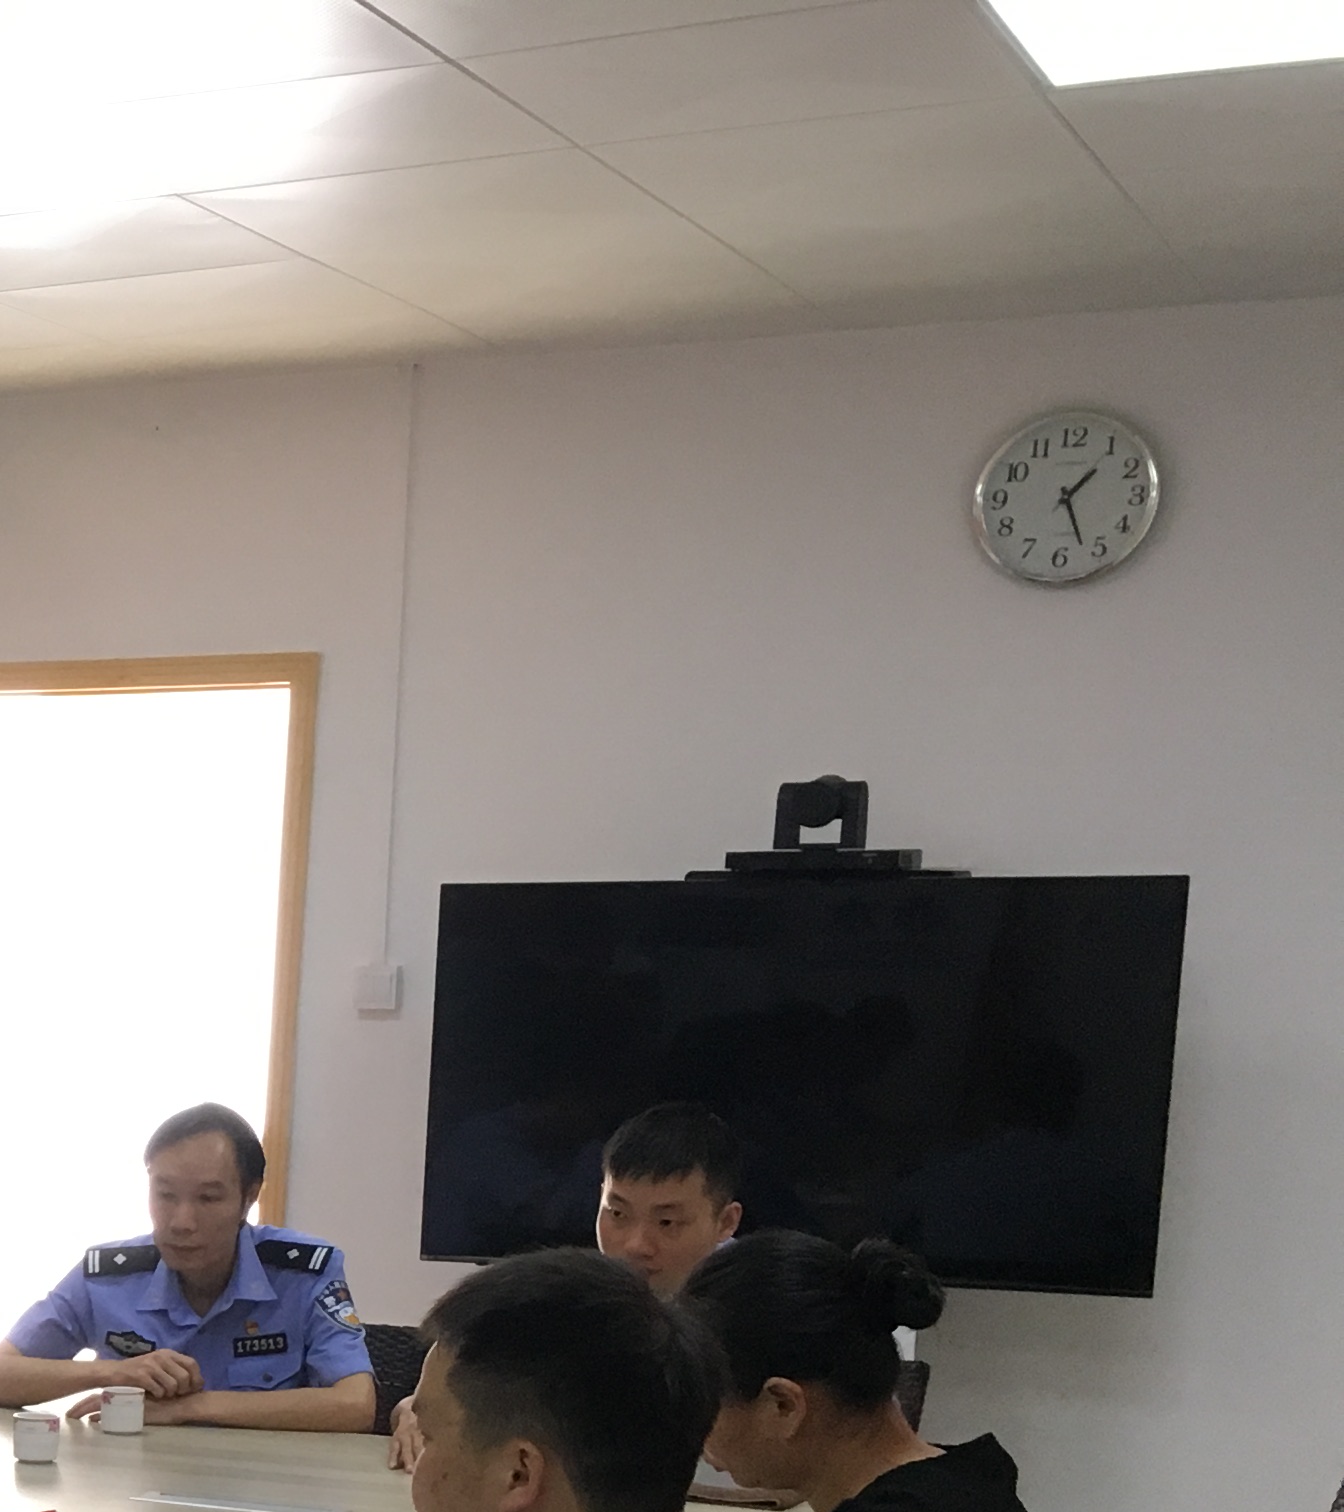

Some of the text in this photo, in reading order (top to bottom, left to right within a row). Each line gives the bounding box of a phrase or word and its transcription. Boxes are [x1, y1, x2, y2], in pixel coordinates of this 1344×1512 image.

[1061, 426, 1088, 448] 12
[1105, 435, 1115, 456] 1
[1031, 438, 1050, 458] 11
[1006, 461, 1030, 482] 10
[1122, 457, 1140, 479] 2
[991, 489, 1009, 511] 9
[1127, 484, 1146, 506] 3
[997, 516, 1014, 537] 8
[1114, 514, 1131, 533] 4
[1021, 538, 1037, 559] 7
[1051, 547, 1069, 568] 6
[1091, 536, 1108, 558] 5
[237, 1336, 284, 1353] 173513
